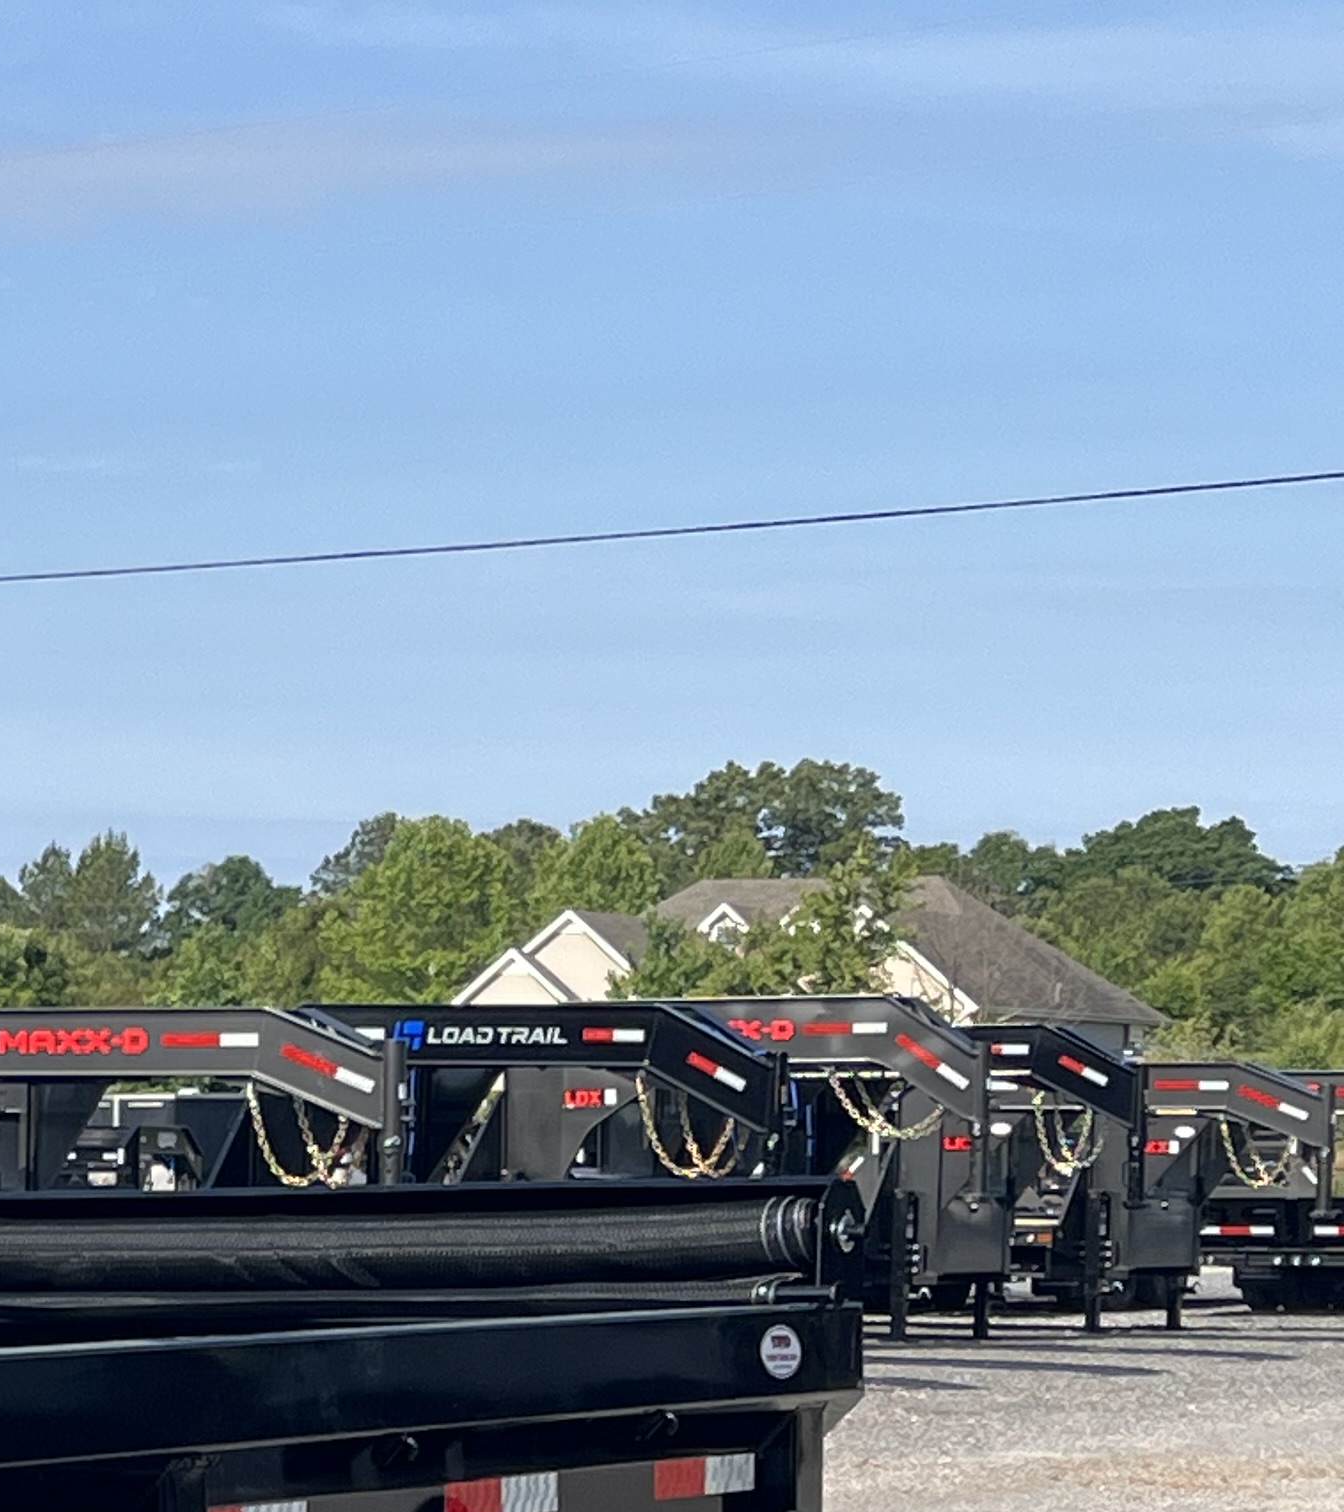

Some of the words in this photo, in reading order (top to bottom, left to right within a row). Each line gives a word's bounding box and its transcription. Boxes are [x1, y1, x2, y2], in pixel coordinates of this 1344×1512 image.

[426, 1026, 494, 1045] LOAD
[495, 1026, 568, 1045] TRAIL
[564, 1088, 602, 1108] LDX
